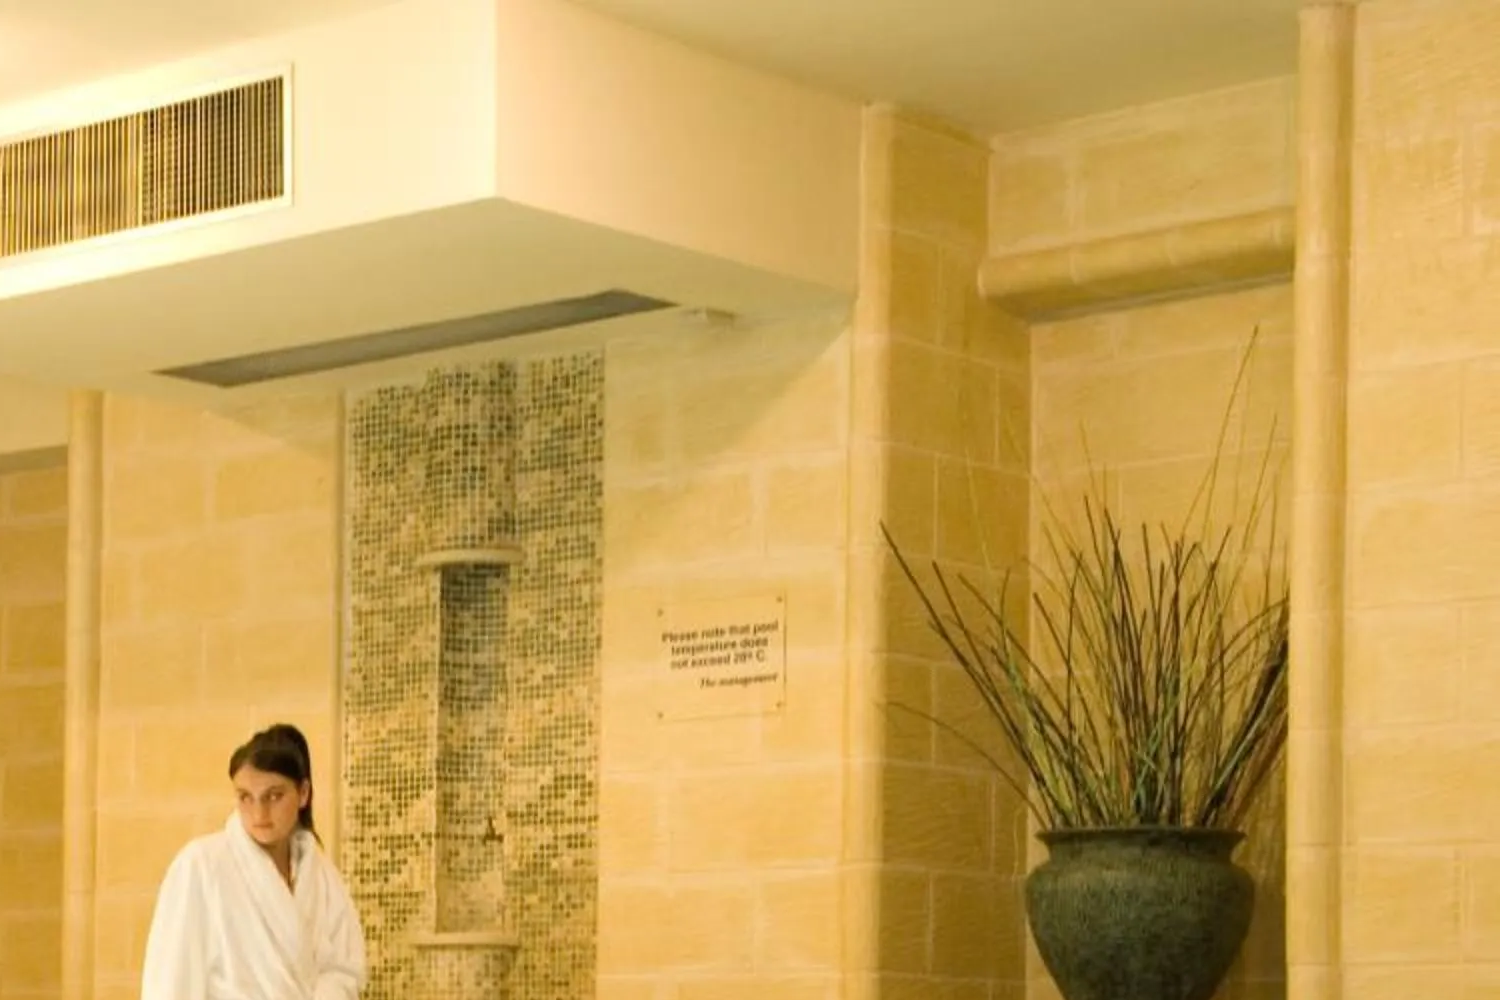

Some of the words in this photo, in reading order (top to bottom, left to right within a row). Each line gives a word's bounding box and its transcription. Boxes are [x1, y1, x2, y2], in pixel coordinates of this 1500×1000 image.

[661, 631, 698, 642] Please
[702, 627, 725, 639] note
[729, 624, 751, 636] that
[753, 619, 778, 636] pool
[671, 640, 737, 656] temperature
[740, 637, 768, 649] does
[691, 654, 730, 668] exceed
